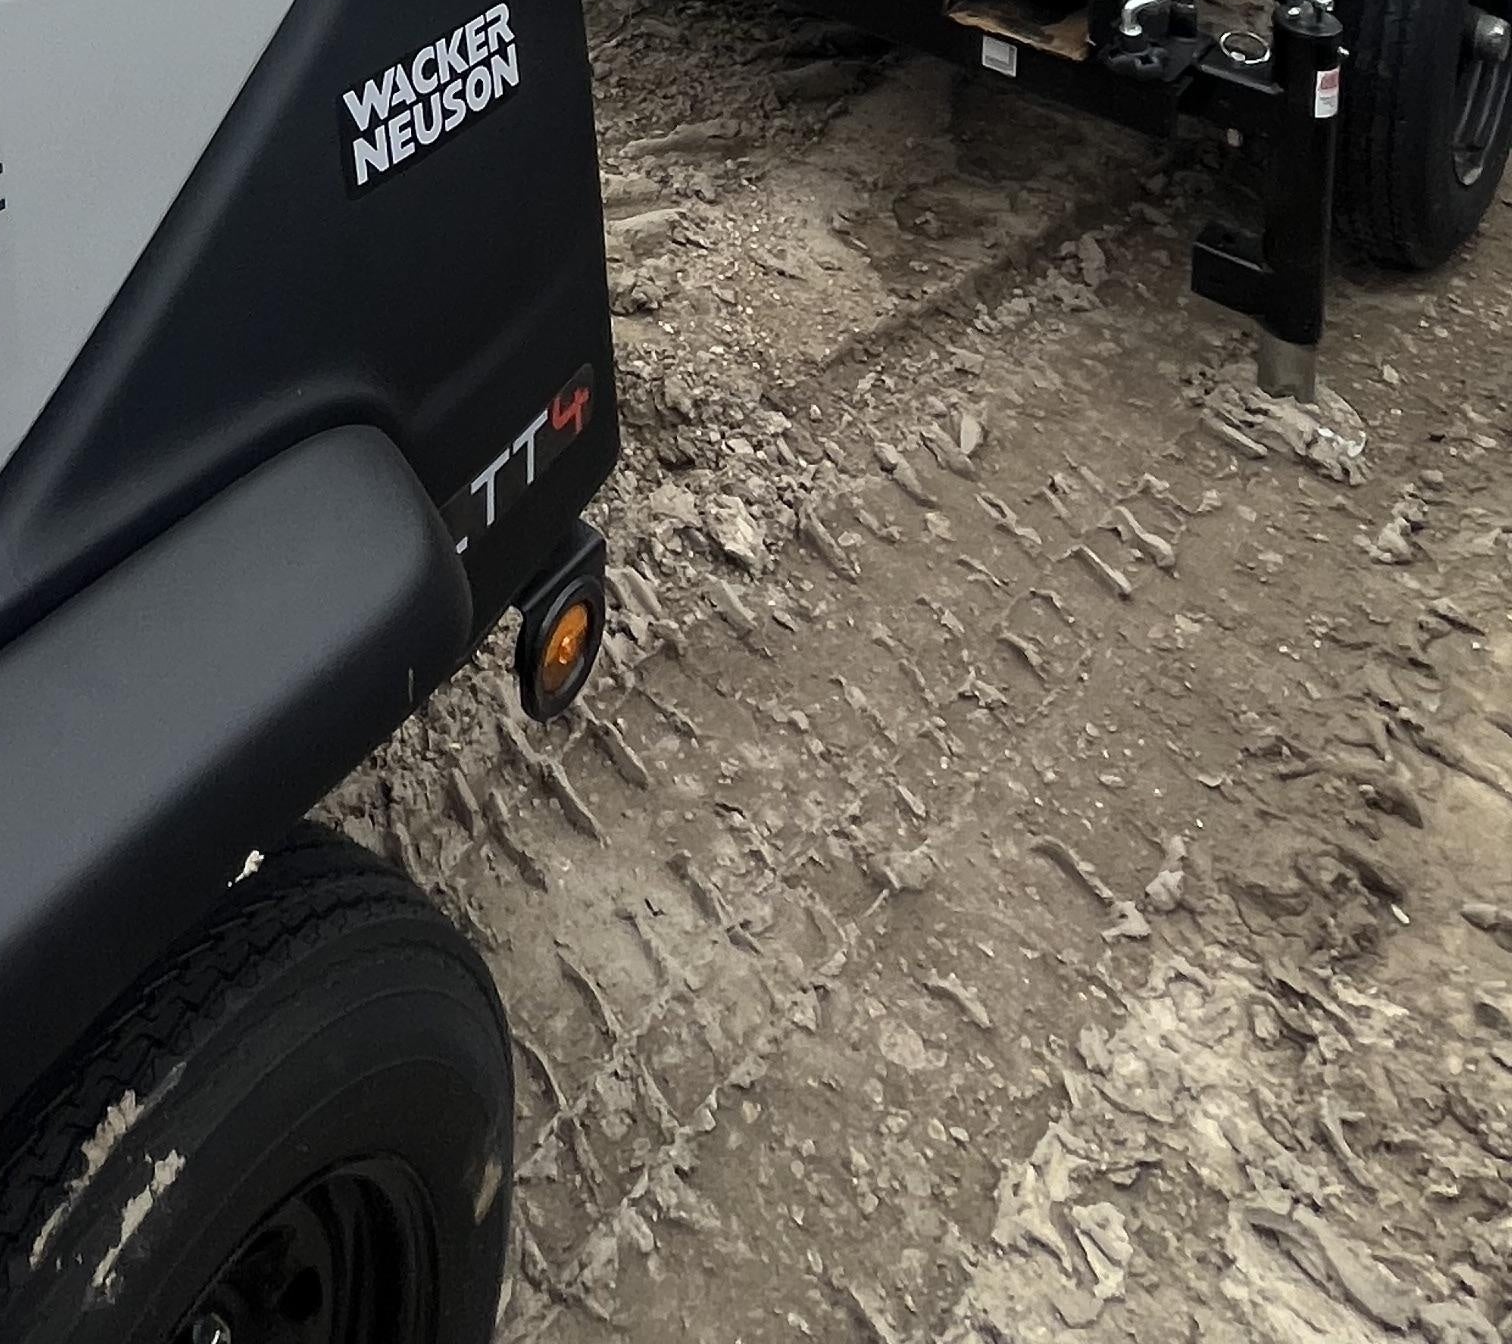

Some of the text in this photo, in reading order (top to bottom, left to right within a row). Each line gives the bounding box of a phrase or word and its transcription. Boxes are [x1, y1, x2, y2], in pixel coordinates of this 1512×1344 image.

[343, 2, 516, 132] WACKER
[352, 44, 520, 186] NEUSON
[455, 386, 591, 554] TT4
